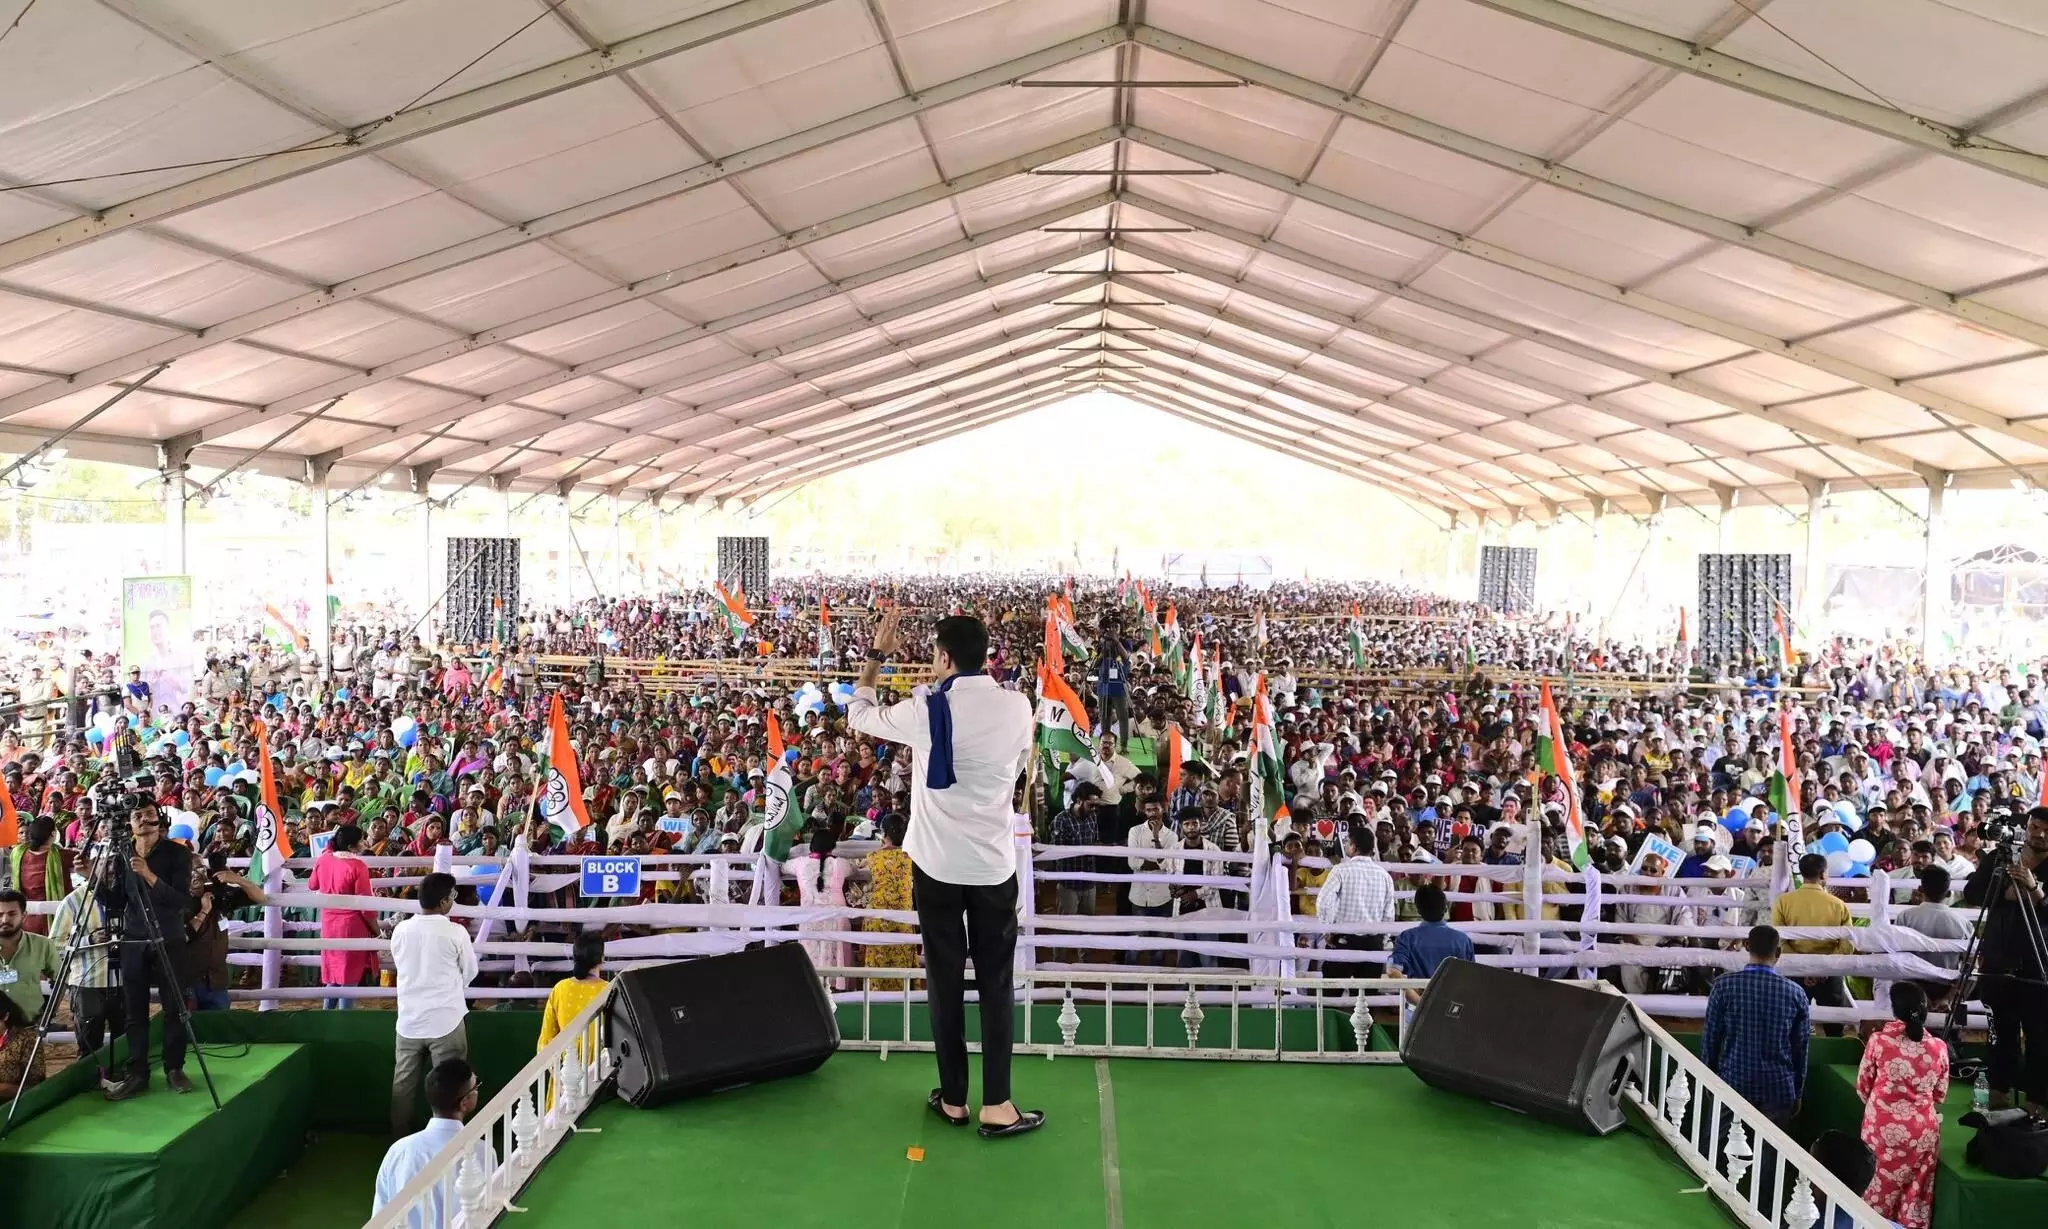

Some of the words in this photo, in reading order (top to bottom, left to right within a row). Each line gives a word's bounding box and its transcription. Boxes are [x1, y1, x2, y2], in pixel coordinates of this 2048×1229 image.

[1049, 706, 1066, 723] M
[663, 820, 687, 832] WE
[1650, 838, 1681, 864] WE
[587, 861, 635, 874] BLOCK
[602, 874, 620, 893] B
